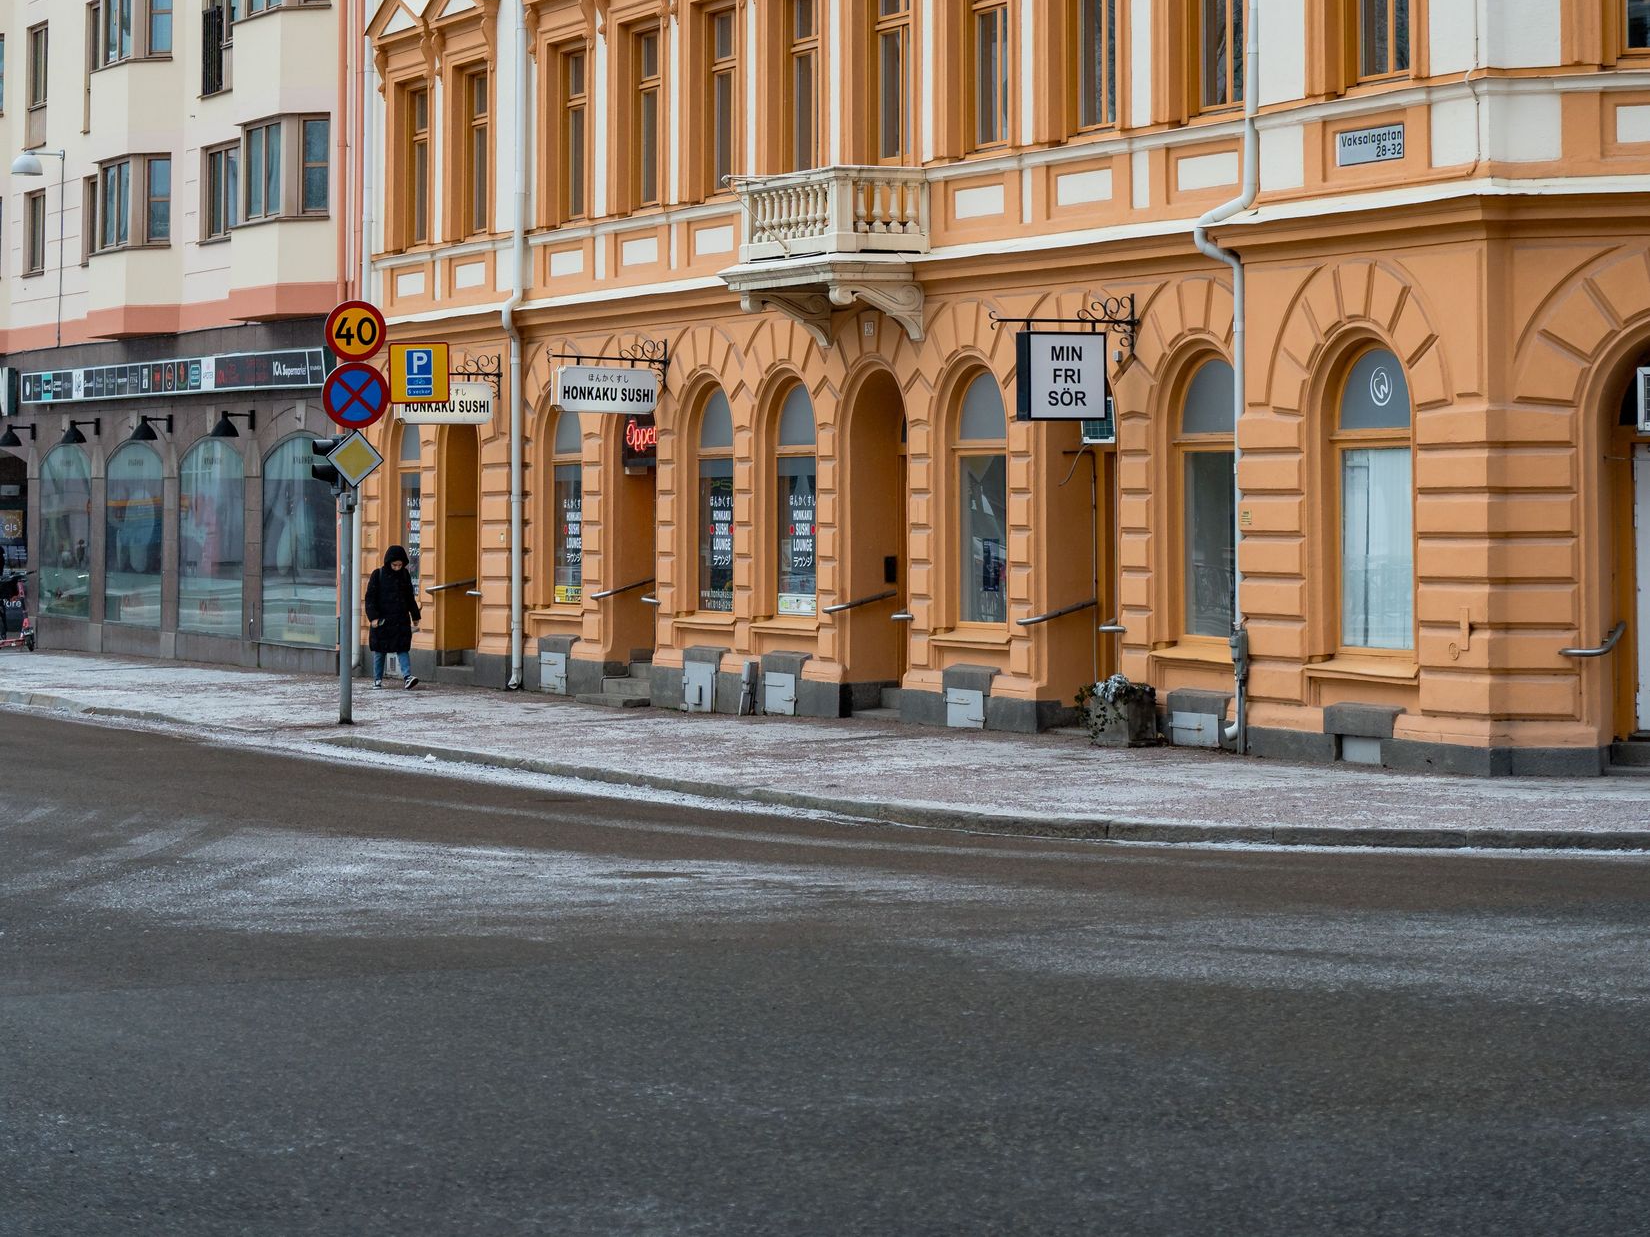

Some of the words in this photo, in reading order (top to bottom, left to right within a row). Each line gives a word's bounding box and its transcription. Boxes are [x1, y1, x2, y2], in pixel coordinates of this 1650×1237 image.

[1341, 130, 1402, 147] Vaksalagatan
[1376, 143, 1402, 157] 28-32
[335, 317, 377, 346] 40
[1051, 346, 1082, 361] MIN
[273, 361, 282, 376] ICA
[282, 363, 306, 378] Supermarket
[413, 352, 428, 374] P
[588, 373, 629, 383] ほんかくすし
[1053, 368, 1080, 383] FRI
[563, 386, 617, 401] HONKAKU
[621, 388, 654, 402] SUSHI
[1048, 388, 1086, 406] SÖR
[405, 400, 455, 413] HONKAKU
[458, 400, 490, 413] SUSHI
[713, 510, 731, 521] HONKAKU
[793, 510, 812, 521] HONKAKU
[568, 523, 580, 535] SUSHI
[715, 523, 728, 535] SUSHI
[795, 523, 810, 536] SUSHI
[713, 538, 731, 551] LOUNGE
[793, 539, 812, 551] LOUNGE
[713, 554, 731, 565] ラウンジ
[793, 555, 813, 567] ラウンジ
